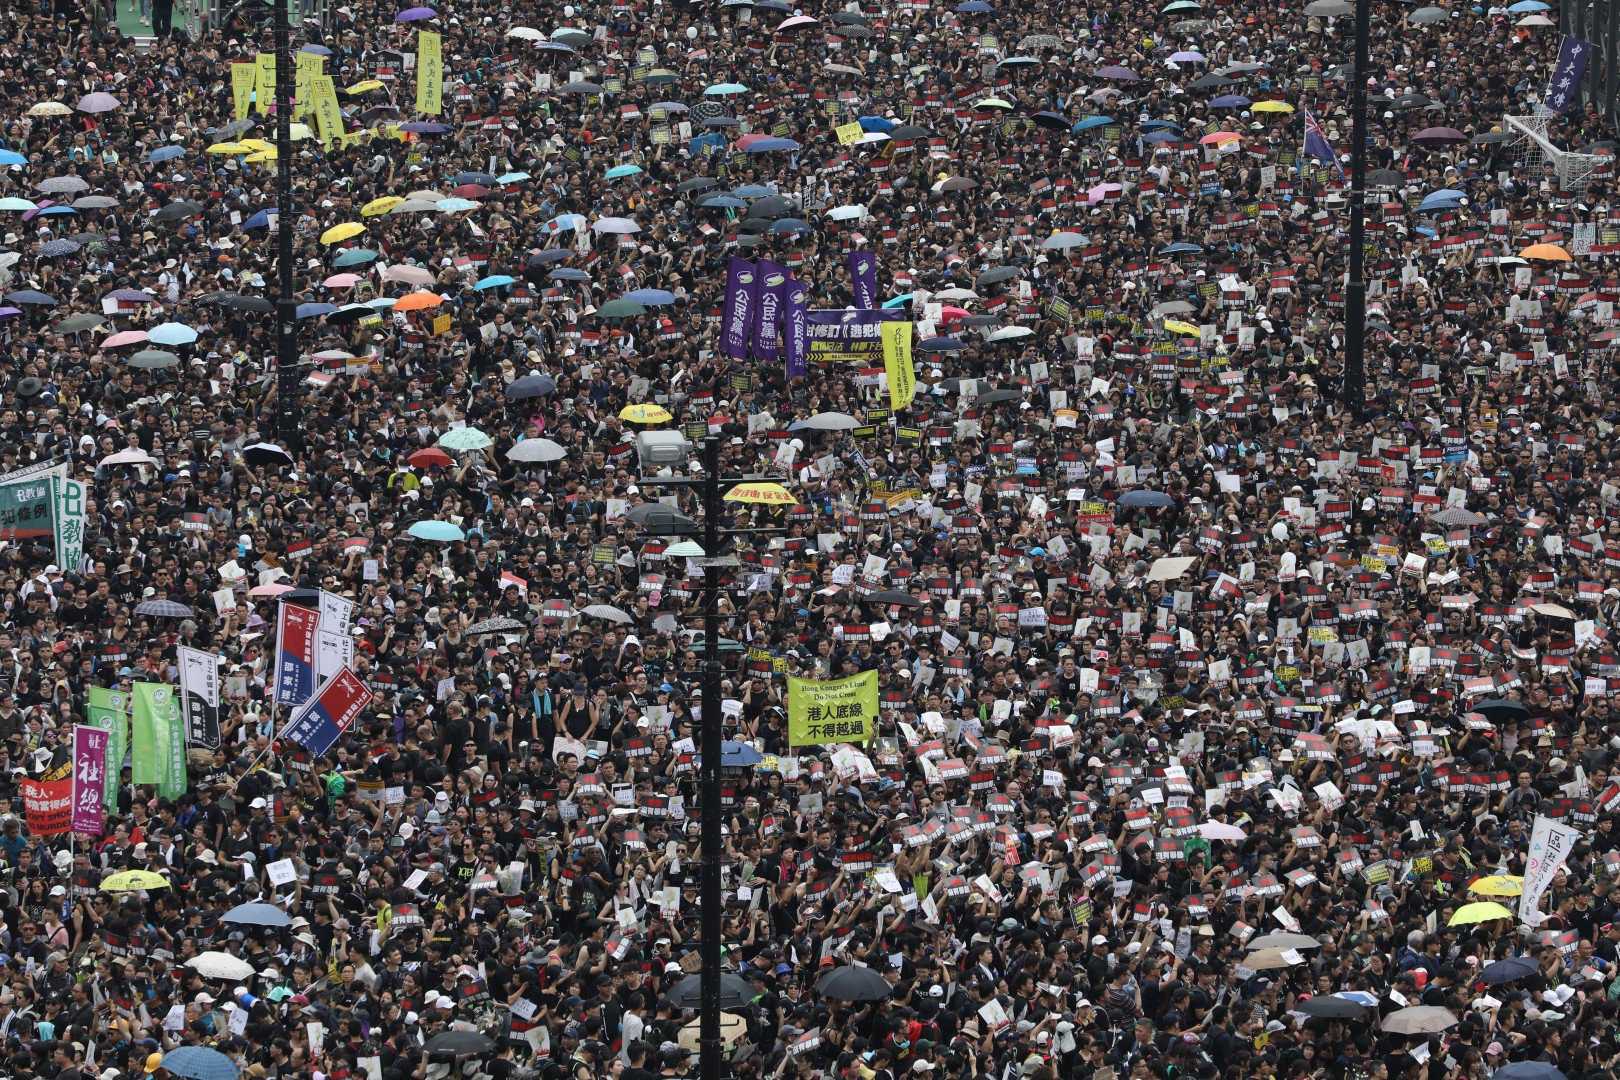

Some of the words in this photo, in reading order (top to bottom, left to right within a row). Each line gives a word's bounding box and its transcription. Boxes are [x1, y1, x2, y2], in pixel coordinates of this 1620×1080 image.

[1554, 44, 1582, 107] 中大新傳
[730, 288, 750, 336] 公民黨
[761, 292, 779, 339] 公民黨
[62, 519, 82, 570] 教協
[802, 685, 819, 693] Hong
[819, 683, 848, 692] Konger's
[849, 680, 867, 689] Limit
[807, 703, 863, 721] 港人底線
[807, 720, 864, 738] 不得越過
[47, 810, 72, 820] SHOO
